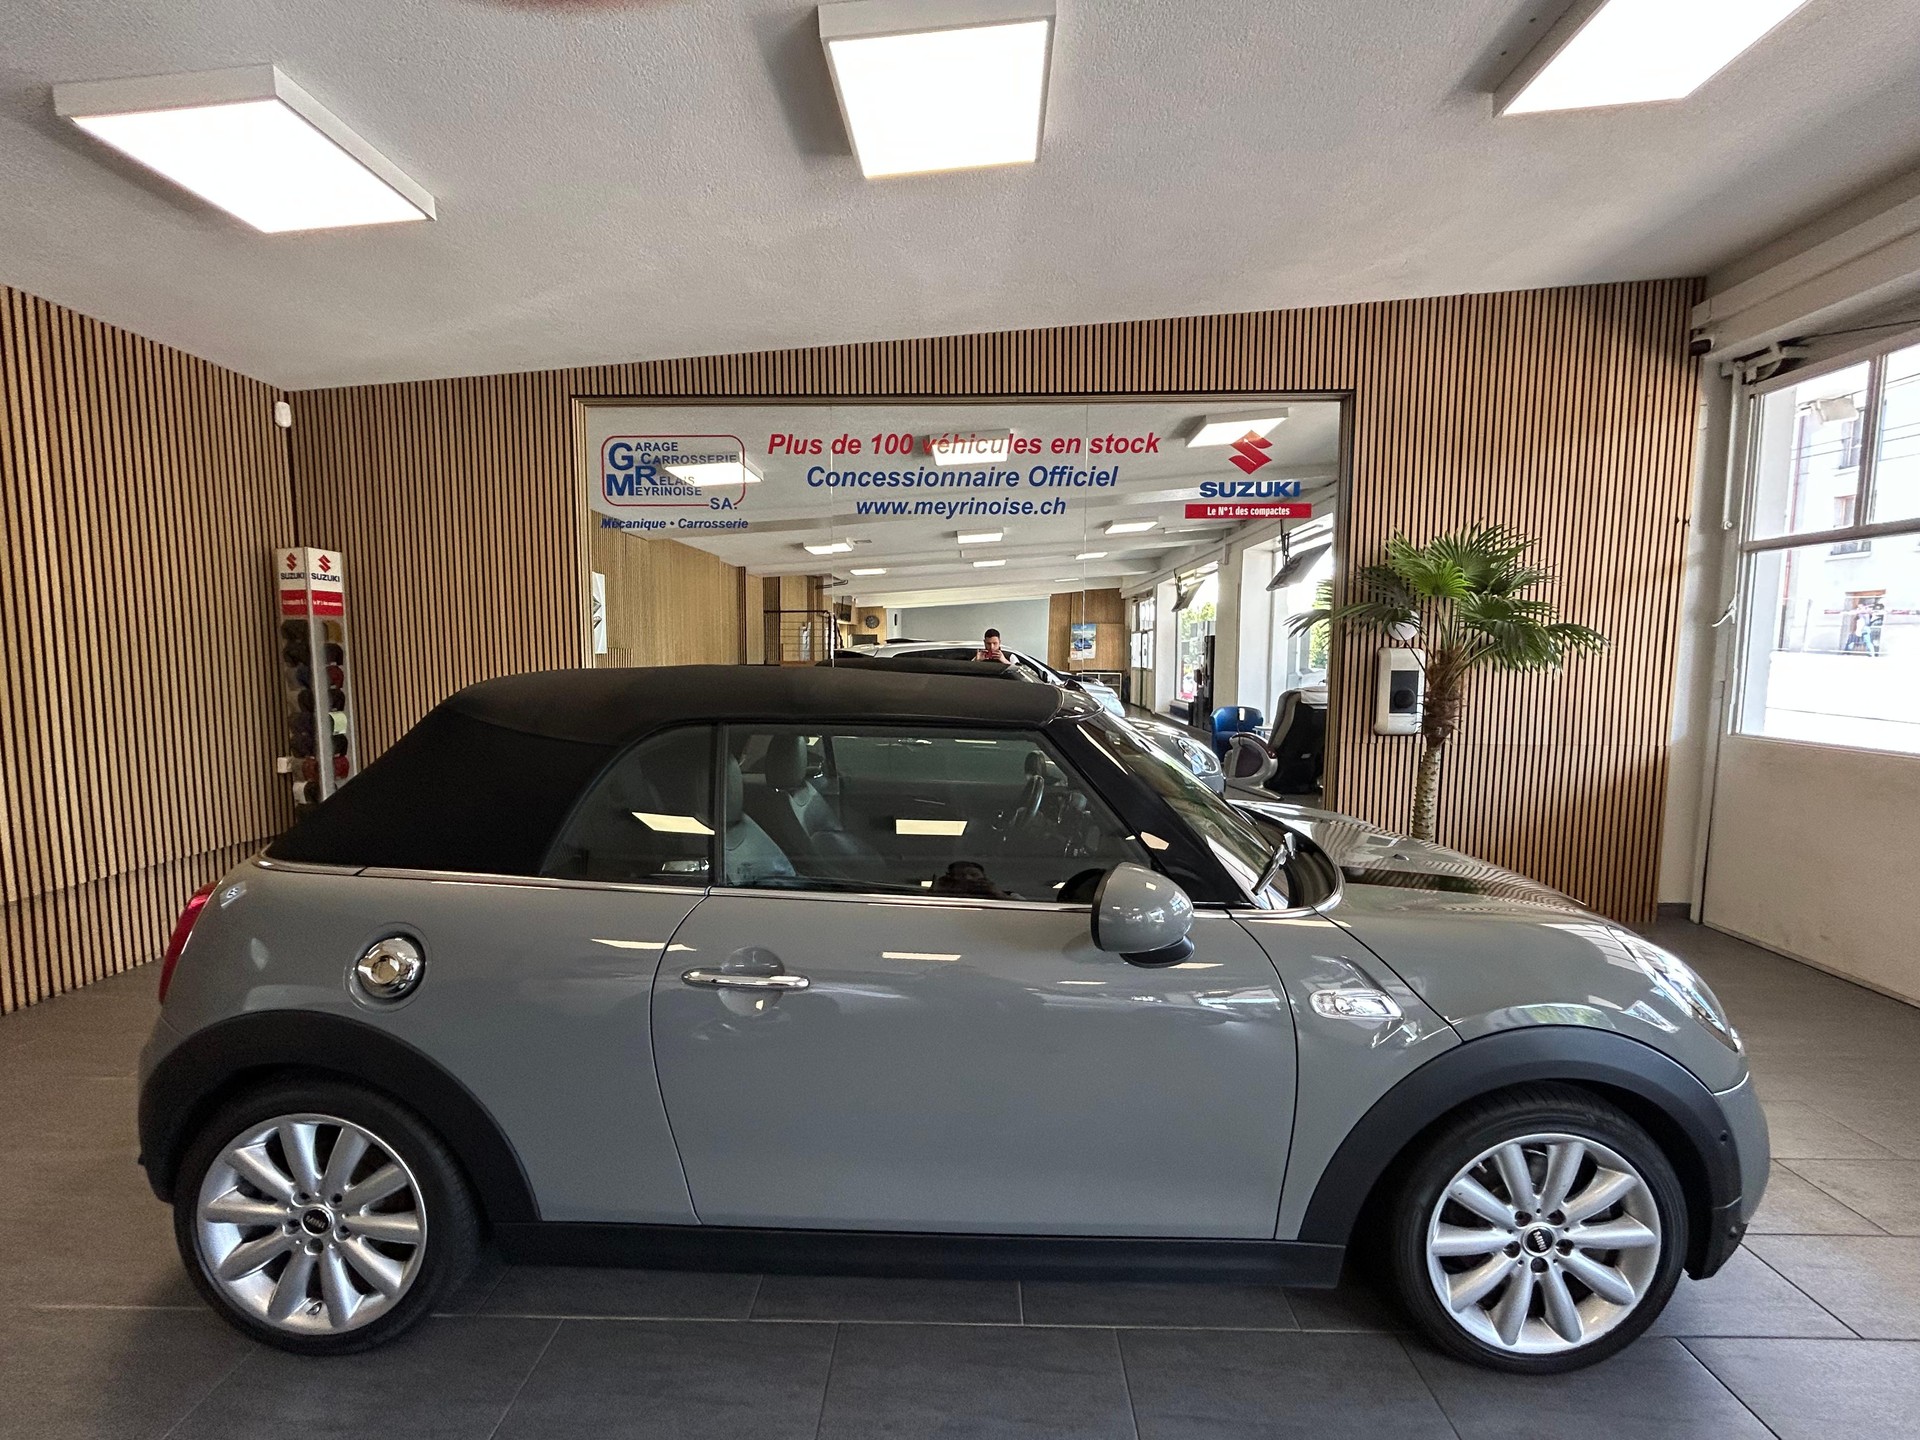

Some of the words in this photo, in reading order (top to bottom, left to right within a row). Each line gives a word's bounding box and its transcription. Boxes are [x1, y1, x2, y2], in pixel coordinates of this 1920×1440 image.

[767, 433, 822, 455] Plus
[831, 433, 861, 455] de
[871, 433, 914, 455] 100
[922, 433, 1042, 455] véhicules
[1050, 437, 1081, 454] en
[1089, 432, 1161, 454] stock
[640, 452, 737, 465] CARROSSERIE
[606, 473, 702, 496] MEYRINOISE
[807, 465, 1019, 488] Concessionnaire
[1028, 465, 1118, 487] Officiel
[1199, 481, 1301, 498] SUZUKI
[856, 496, 1067, 519] www.meyrinoise.ch
[1207, 506, 1216, 515] Le
[1235, 506, 1249, 515] des
[1250, 506, 1290, 517] compactes
[678, 518, 749, 529] Carrosserie
[280, 572, 305, 580] SUZUKI
[311, 573, 340, 582] SUZUKI
[1533, 1230, 1547, 1251] MINI
